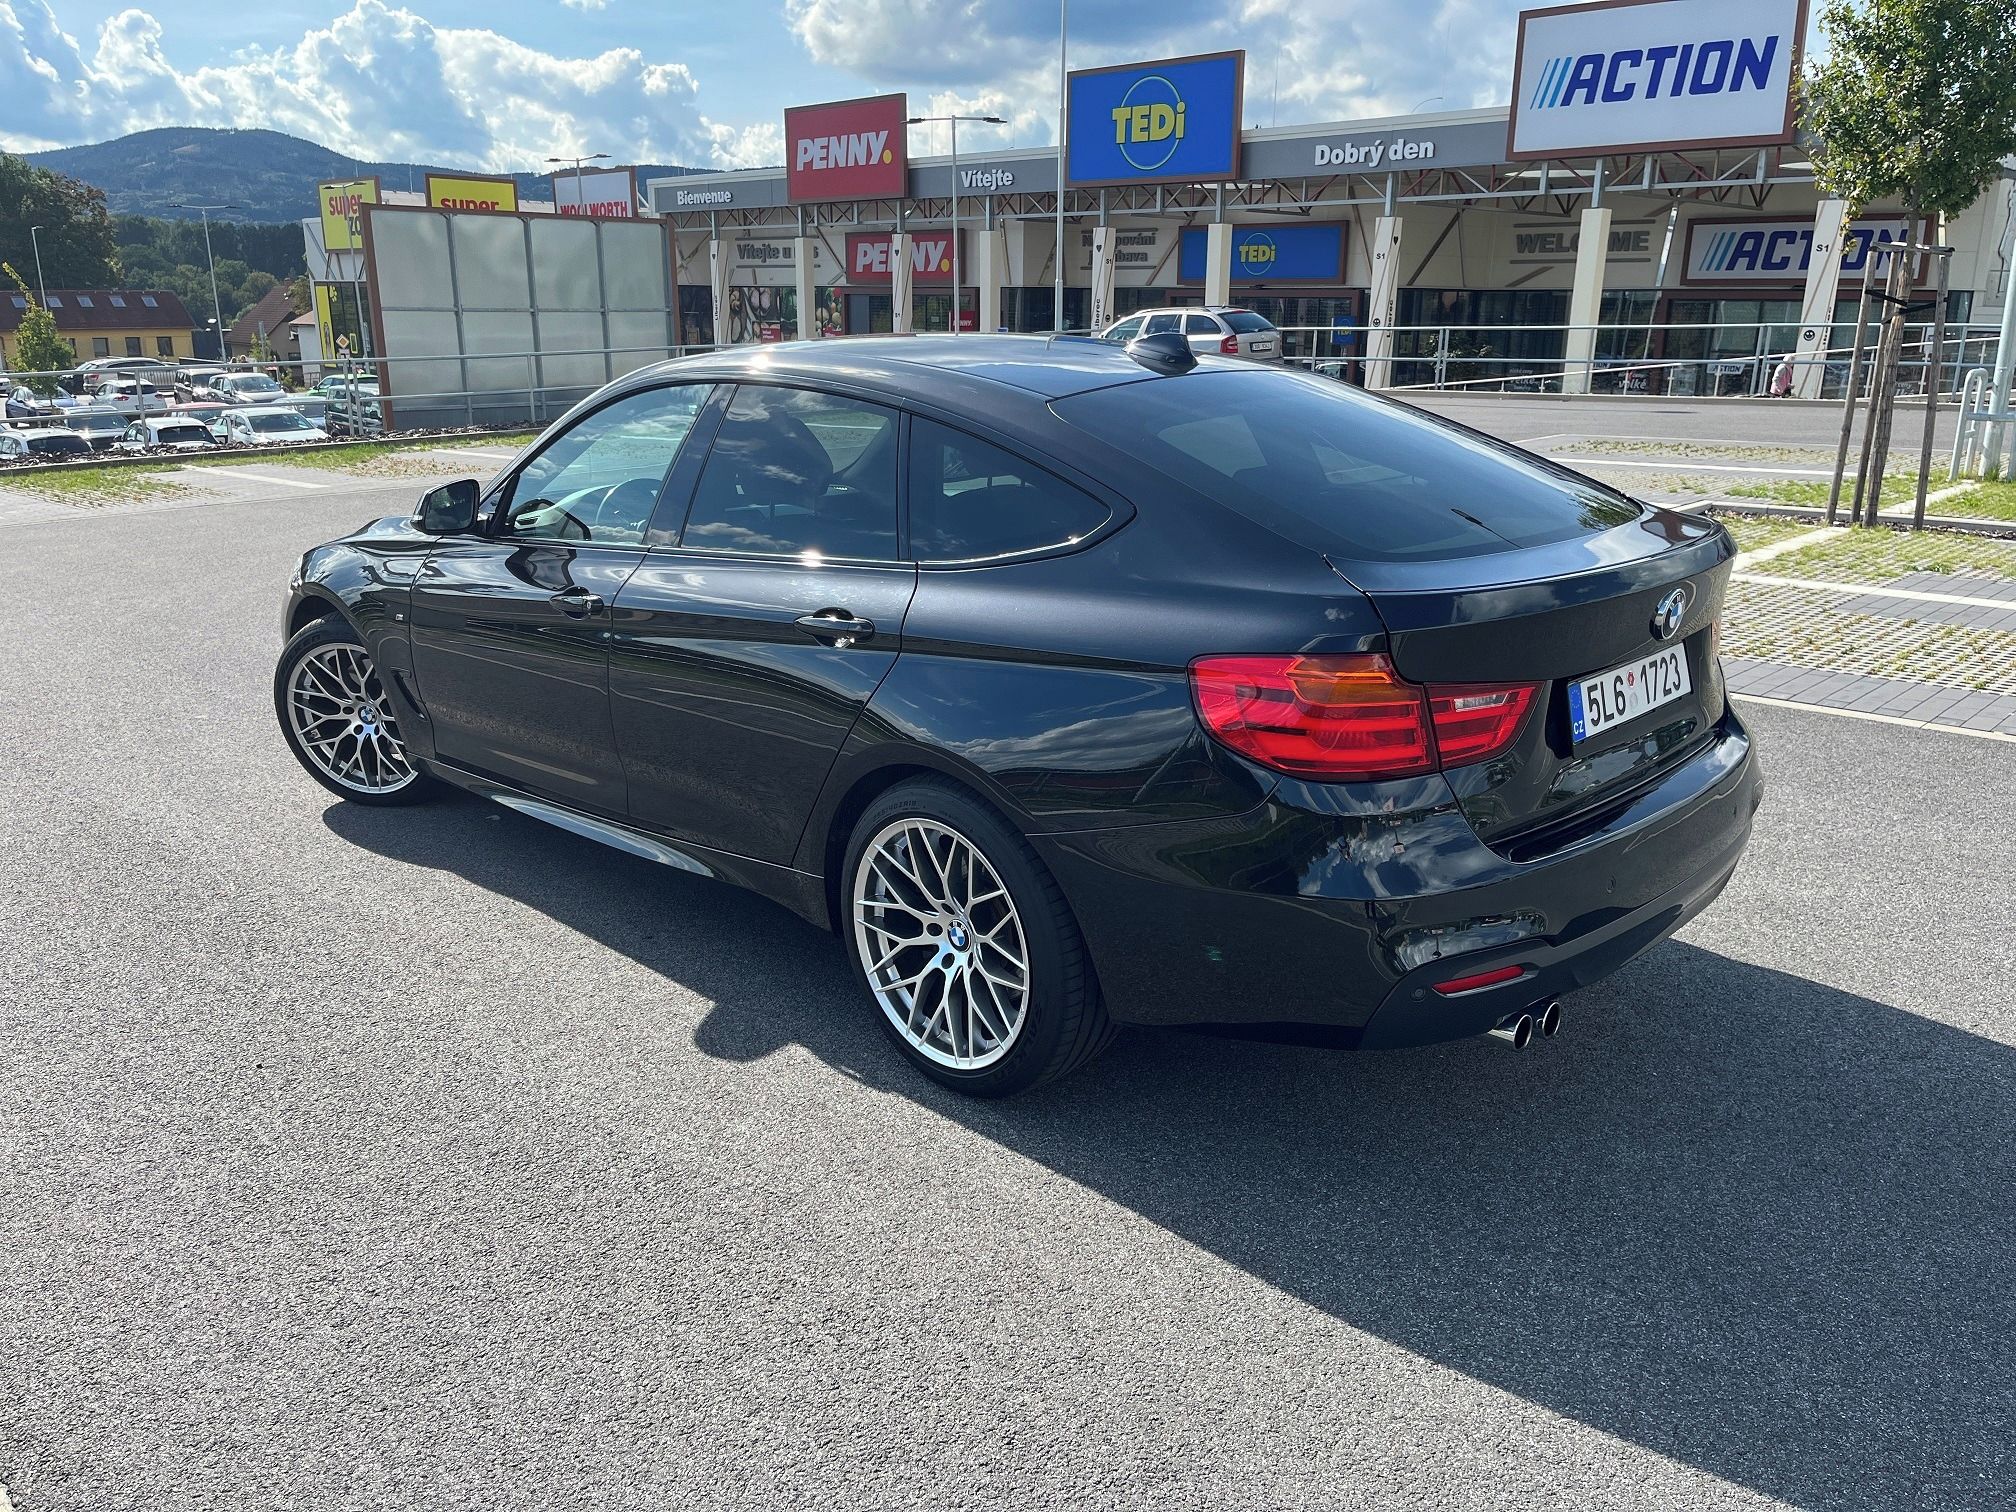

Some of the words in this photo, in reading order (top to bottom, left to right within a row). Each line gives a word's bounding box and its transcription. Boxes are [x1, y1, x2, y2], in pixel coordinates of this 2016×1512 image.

[1560, 36, 1779, 106] ACTION
[1112, 101, 1186, 144] TEDi
[1315, 139, 1385, 167] Dobrý
[1388, 139, 1435, 162] den
[960, 169, 1015, 191] Vítejte
[440, 197, 500, 211] super
[676, 190, 732, 205] Bienvenue
[736, 244, 780, 263] Vítejte
[782, 249, 792, 259] u
[1082, 233, 1156, 254] Npování
[1239, 241, 1276, 263] TEDi
[1516, 231, 1650, 254] WELME
[1725, 228, 1908, 271] ACTON
[1815, 244, 1830, 252] S1
[856, 241, 950, 273] PENY.
[1115, 250, 1148, 262] bava
[1587, 674, 1626, 727] 5L6
[1640, 652, 1681, 705] 1723
[1573, 719, 1585, 735] CZ
